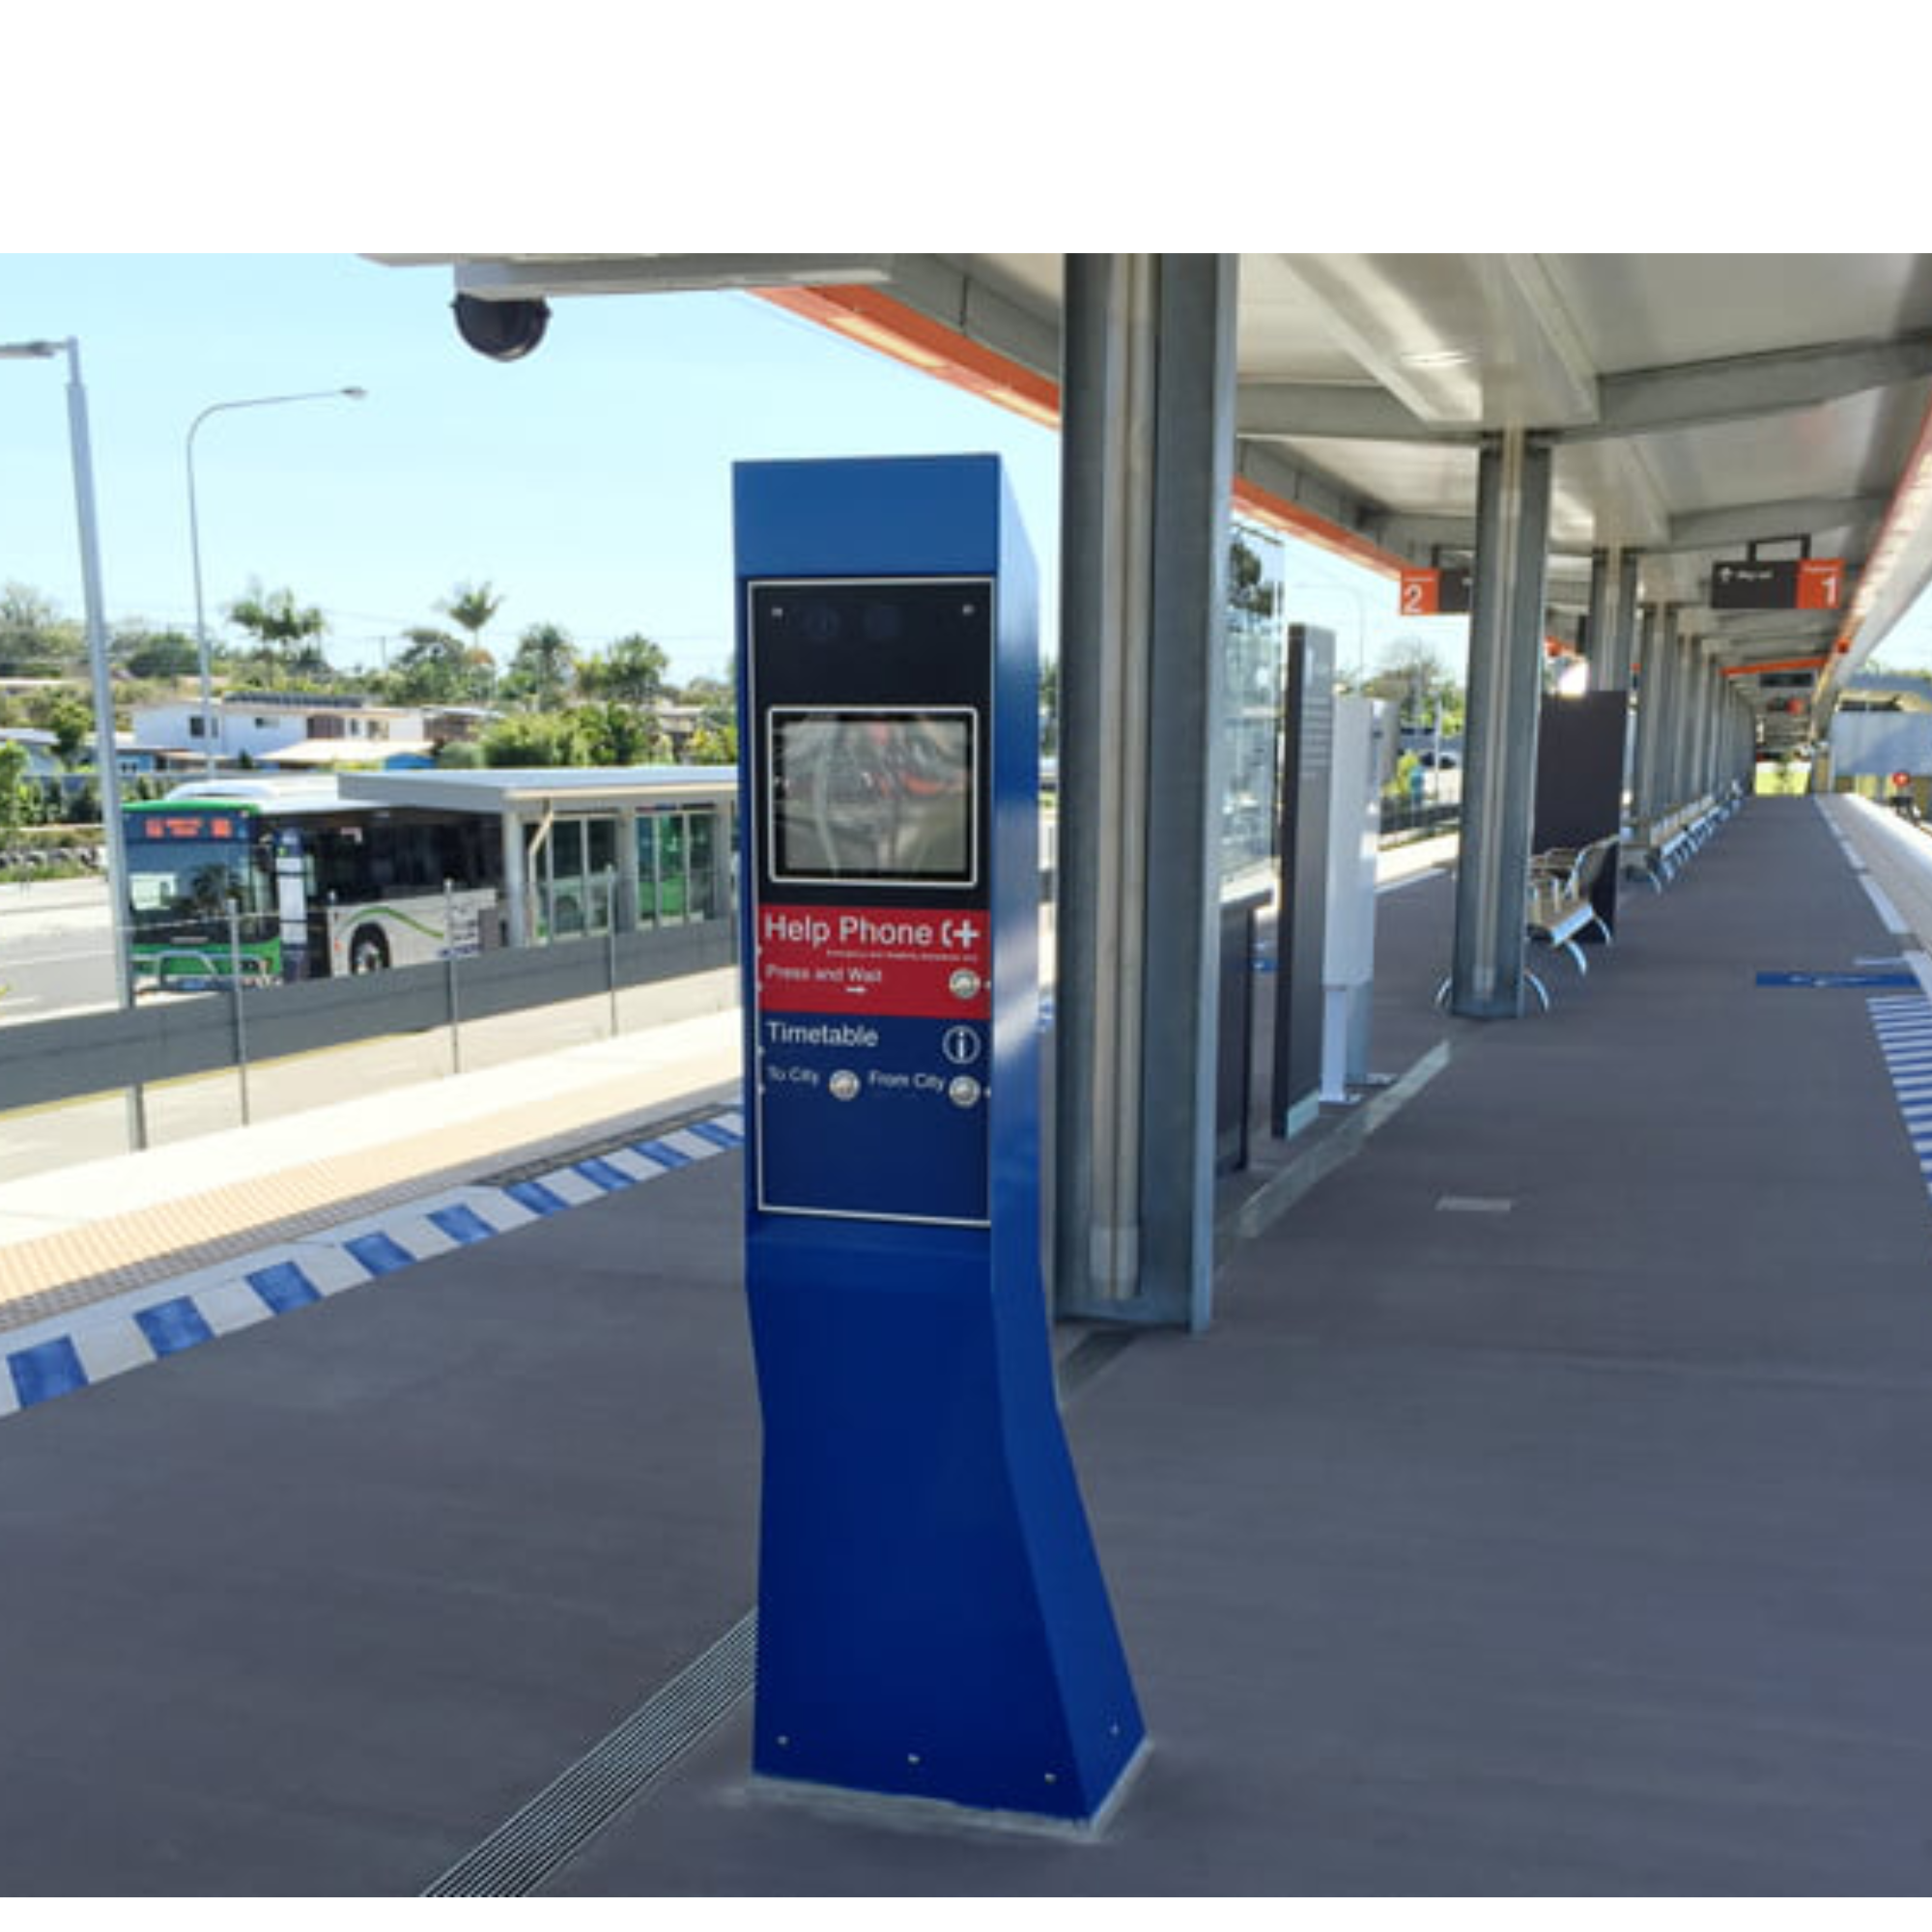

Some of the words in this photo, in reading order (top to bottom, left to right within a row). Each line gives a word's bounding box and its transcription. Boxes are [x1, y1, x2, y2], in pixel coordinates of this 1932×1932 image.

[765, 914, 830, 948] Help
[838, 916, 933, 946] Phone
[766, 965, 810, 980] Press
[816, 967, 843, 981] and
[766, 1020, 879, 1046] Timetable
[868, 1070, 909, 1087] From
[914, 1073, 946, 1093] City
